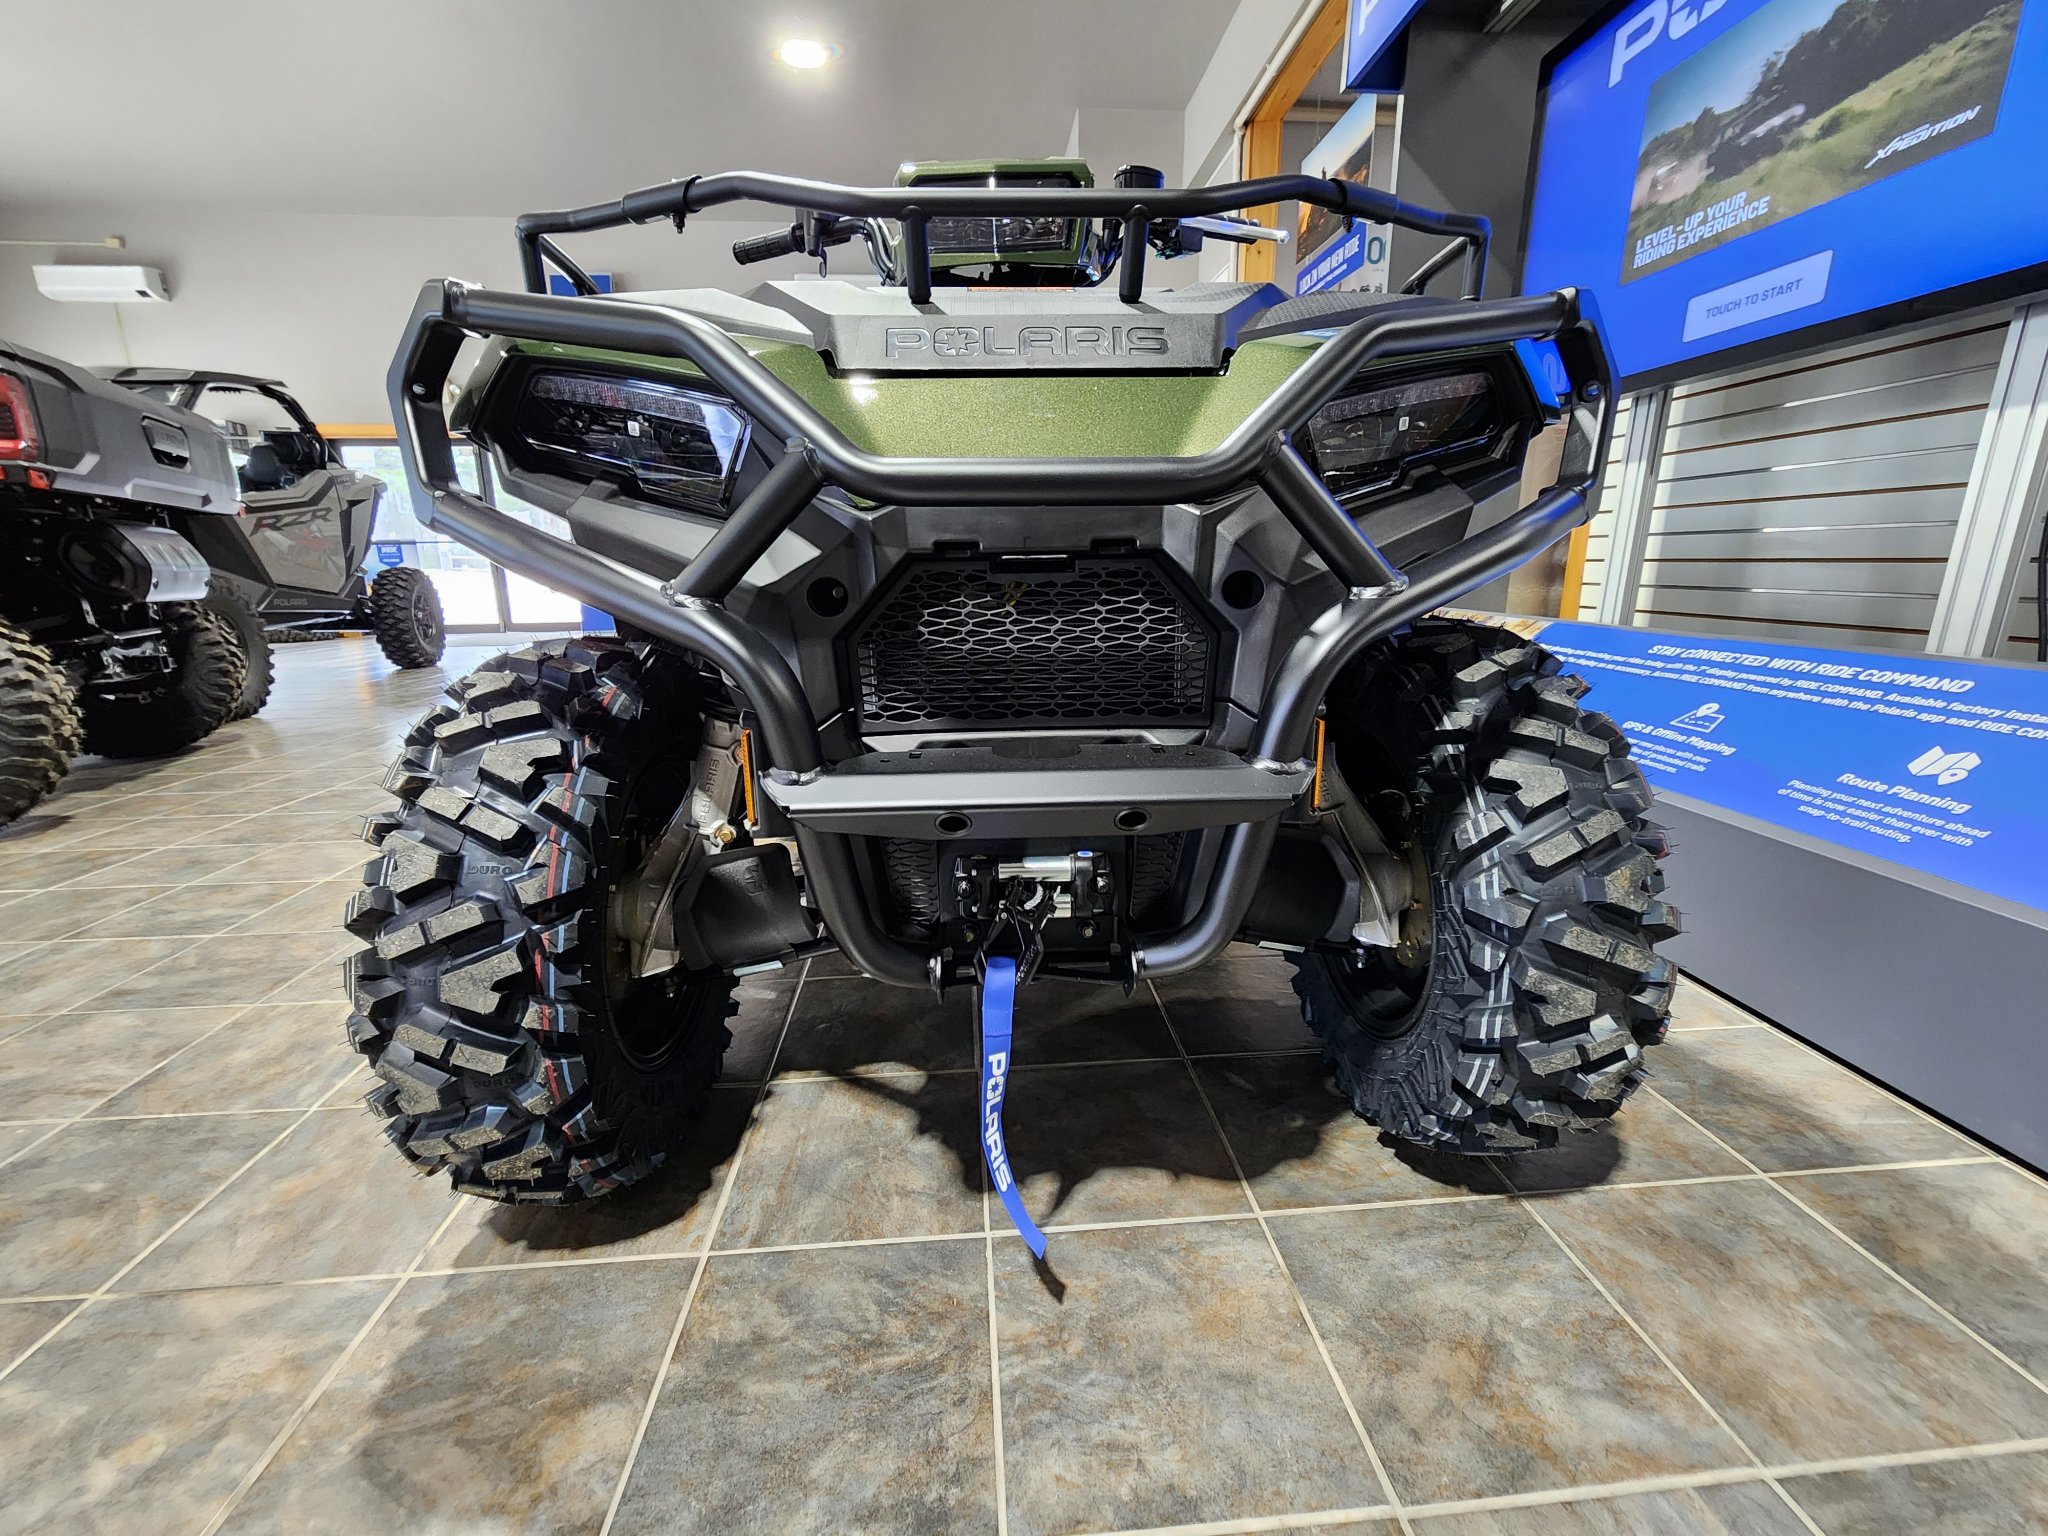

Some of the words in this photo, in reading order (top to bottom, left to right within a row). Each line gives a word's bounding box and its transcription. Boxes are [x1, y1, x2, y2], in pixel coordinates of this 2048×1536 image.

[1706, 192, 1748, 224] YOUR
[1633, 239, 1676, 269] RIDING
[1676, 196, 1771, 250] EXPERIENCE
[1705, 297, 1743, 319] TOUCH
[1744, 293, 1759, 307] TO
[1760, 279, 1803, 301] START
[886, 326, 1171, 358] POLARIS
[249, 507, 332, 537] RZR
[1648, 645, 1683, 658] STAY
[1680, 648, 1770, 667] CONNECTED
[1767, 658, 1817, 673] WITH
[1812, 663, 1863, 679] RIDE
[1858, 669, 1975, 693] COMMAND
[1679, 674, 1701, 683] RIDE
[1699, 677, 1747, 690] COMMAND
[1746, 684, 1770, 694] from
[1768, 689, 1822, 703] anywhere
[1821, 697, 1850, 707] with
[1848, 701, 1871, 711] the
[1869, 704, 1918, 718] Polaris
[1916, 713, 1947, 723] app
[1945, 717, 1976, 728] and
[1975, 721, 2020, 734] RIDE
[1706, 667, 1738, 678] display
[1736, 672, 1781, 684] powered
[1794, 680, 1823, 690] RIDE
[1820, 683, 1884, 699] COMMAND.
[1884, 693, 1948, 708] Available
[1947, 702, 2006, 718] factory
[1622, 720, 1646, 732] GPS
[1651, 728, 1688, 743] Offline
[1685, 735, 1737, 756] Mapping
[1787, 779, 1832, 798] Planning
[1830, 791, 1859, 803] your
[1855, 798, 1884, 810] next
[1880, 805, 1947, 827] adventure
[1944, 821, 1993, 839] ahead
[1836, 773, 1889, 793] Route
[1887, 785, 1973, 815] Planning
[1789, 788, 1814, 802] time
[1824, 800, 1848, 811] now
[1846, 805, 1884, 822] easier
[1882, 816, 1912, 830] than
[1910, 825, 1942, 838] ever
[1940, 833, 1975, 847] with
[1798, 804, 1869, 830] snap-to-trail
[1865, 825, 1912, 843] routing.
[467, 865, 513, 875] DURO
[985, 1052, 1012, 1192] POLARIS
